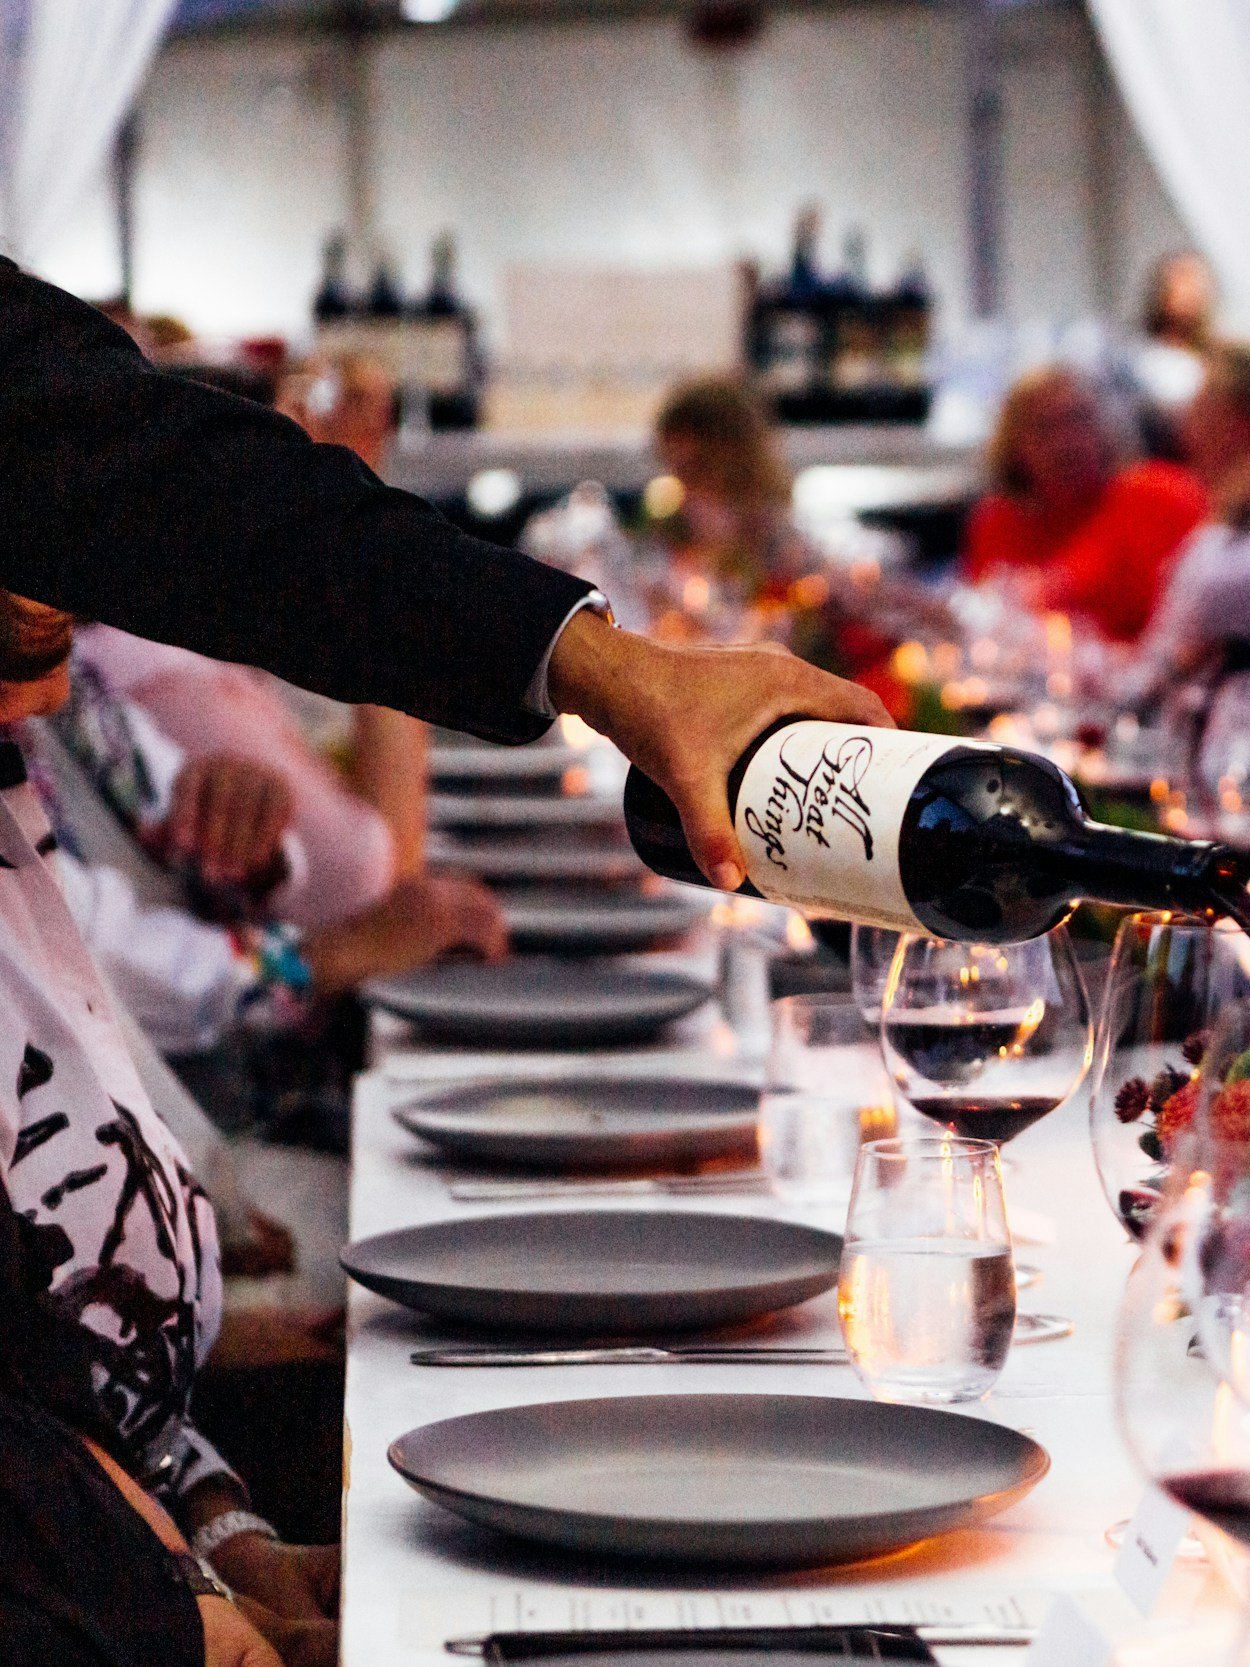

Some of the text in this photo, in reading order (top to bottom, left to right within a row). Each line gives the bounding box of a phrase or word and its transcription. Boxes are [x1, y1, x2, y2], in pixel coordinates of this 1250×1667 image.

[744, 732, 825, 871] Things
[806, 737, 873, 849] Great
[832, 746, 874, 861] All
